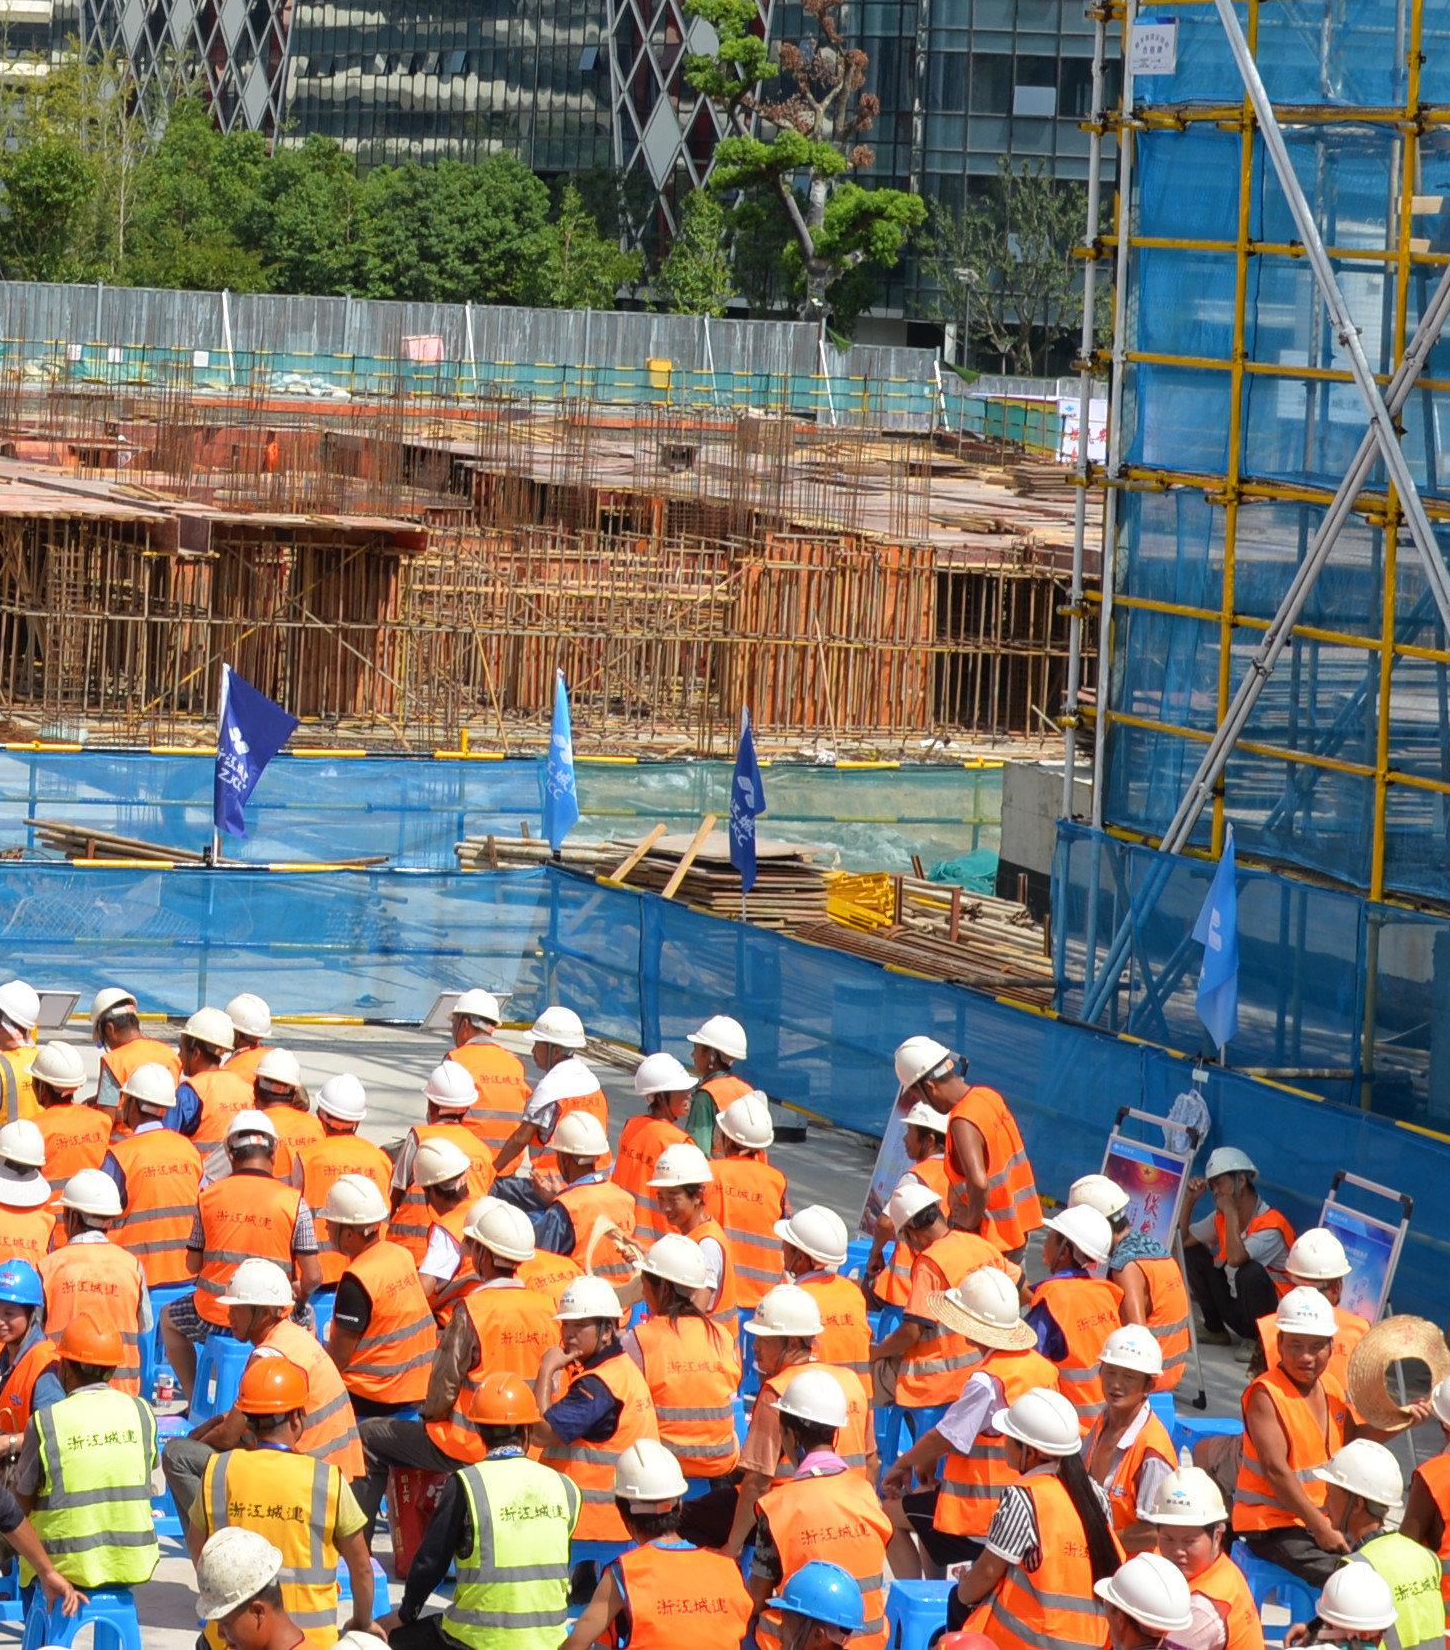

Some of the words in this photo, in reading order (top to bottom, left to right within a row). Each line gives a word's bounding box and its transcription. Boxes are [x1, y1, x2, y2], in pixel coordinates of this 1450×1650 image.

[68, 1430, 138, 1450] 浙江城建
[229, 1502, 305, 1524] 浙江城建
[500, 1506, 567, 1522] 浙江城建
[801, 1523, 871, 1546] 浙江城建
[1064, 1540, 1090, 1559] 浙江
[657, 1598, 728, 1616] 浙江城建
